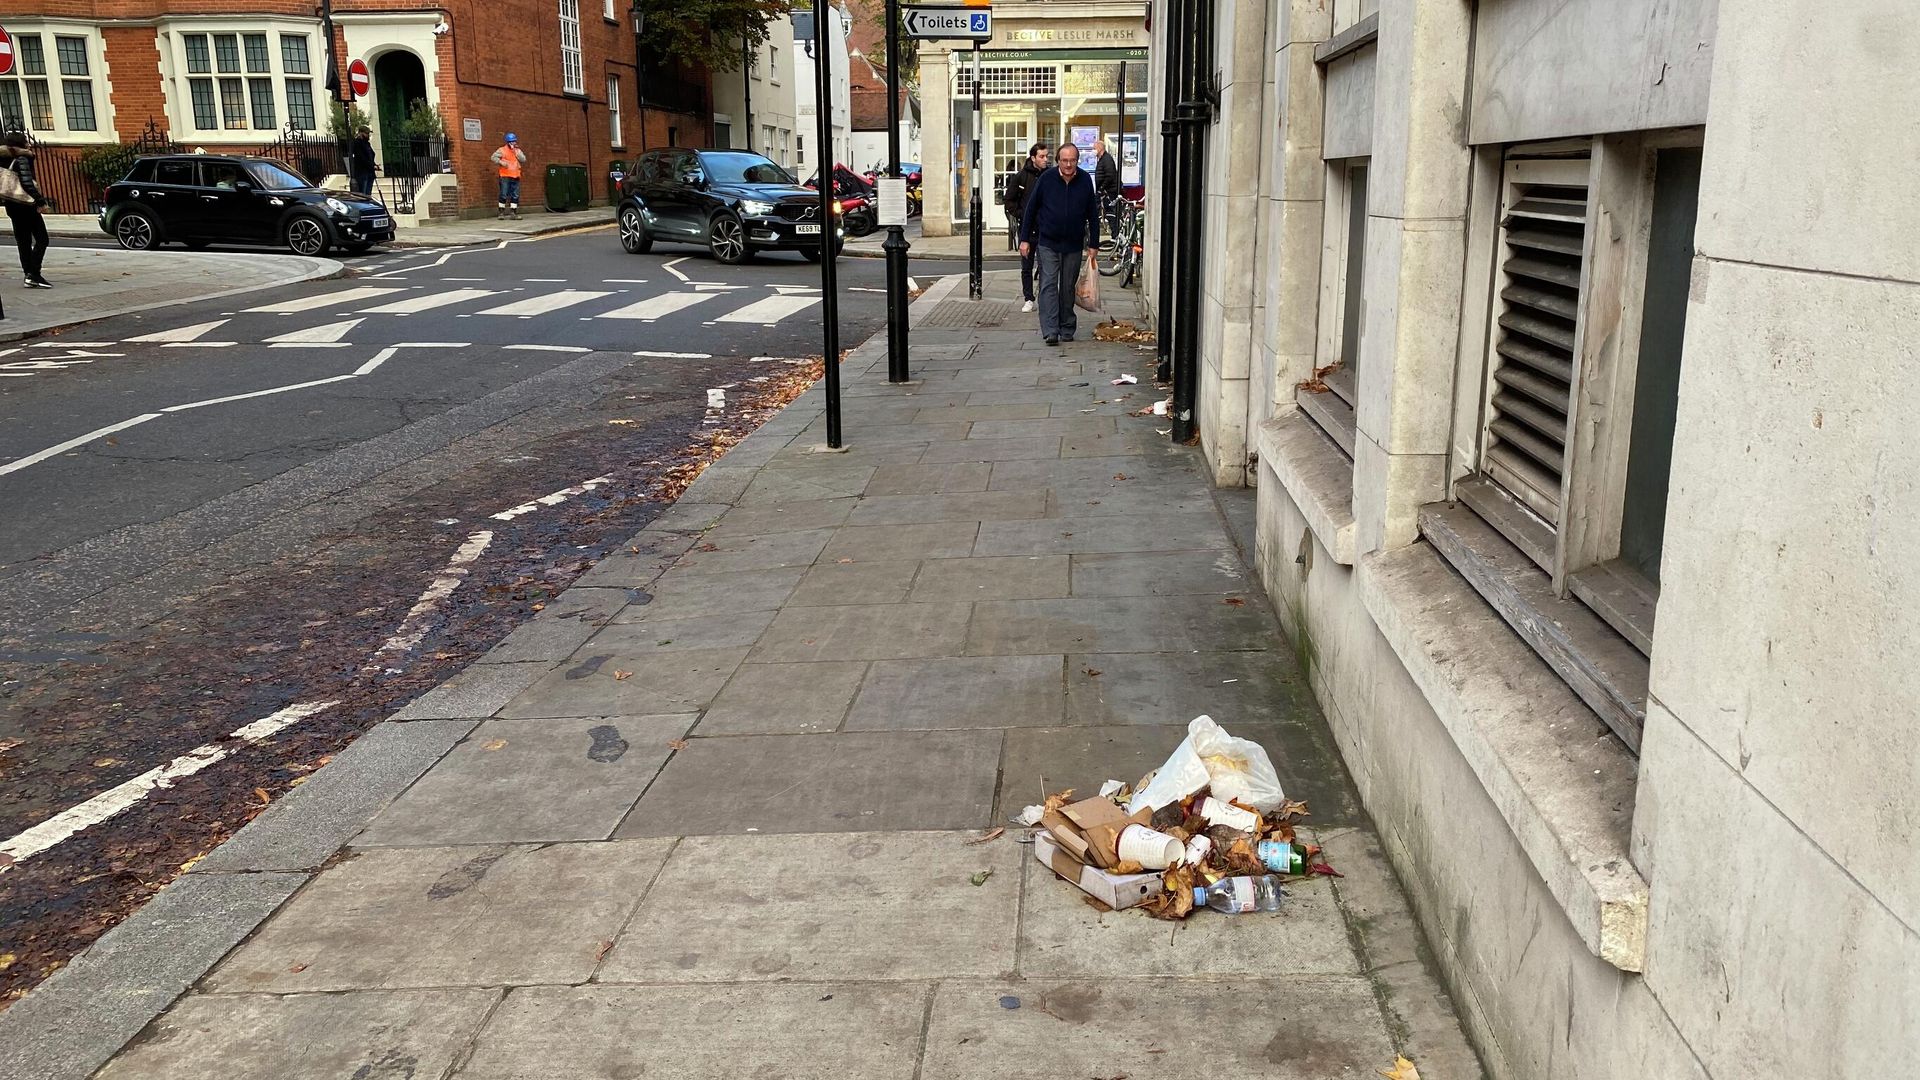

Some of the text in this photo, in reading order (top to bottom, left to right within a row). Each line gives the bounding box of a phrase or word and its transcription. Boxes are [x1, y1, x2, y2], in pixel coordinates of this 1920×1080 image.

[919, 16, 967, 28] Toilets
[1006, 30, 1134, 40] BECTIVE LESLIE MARSH
